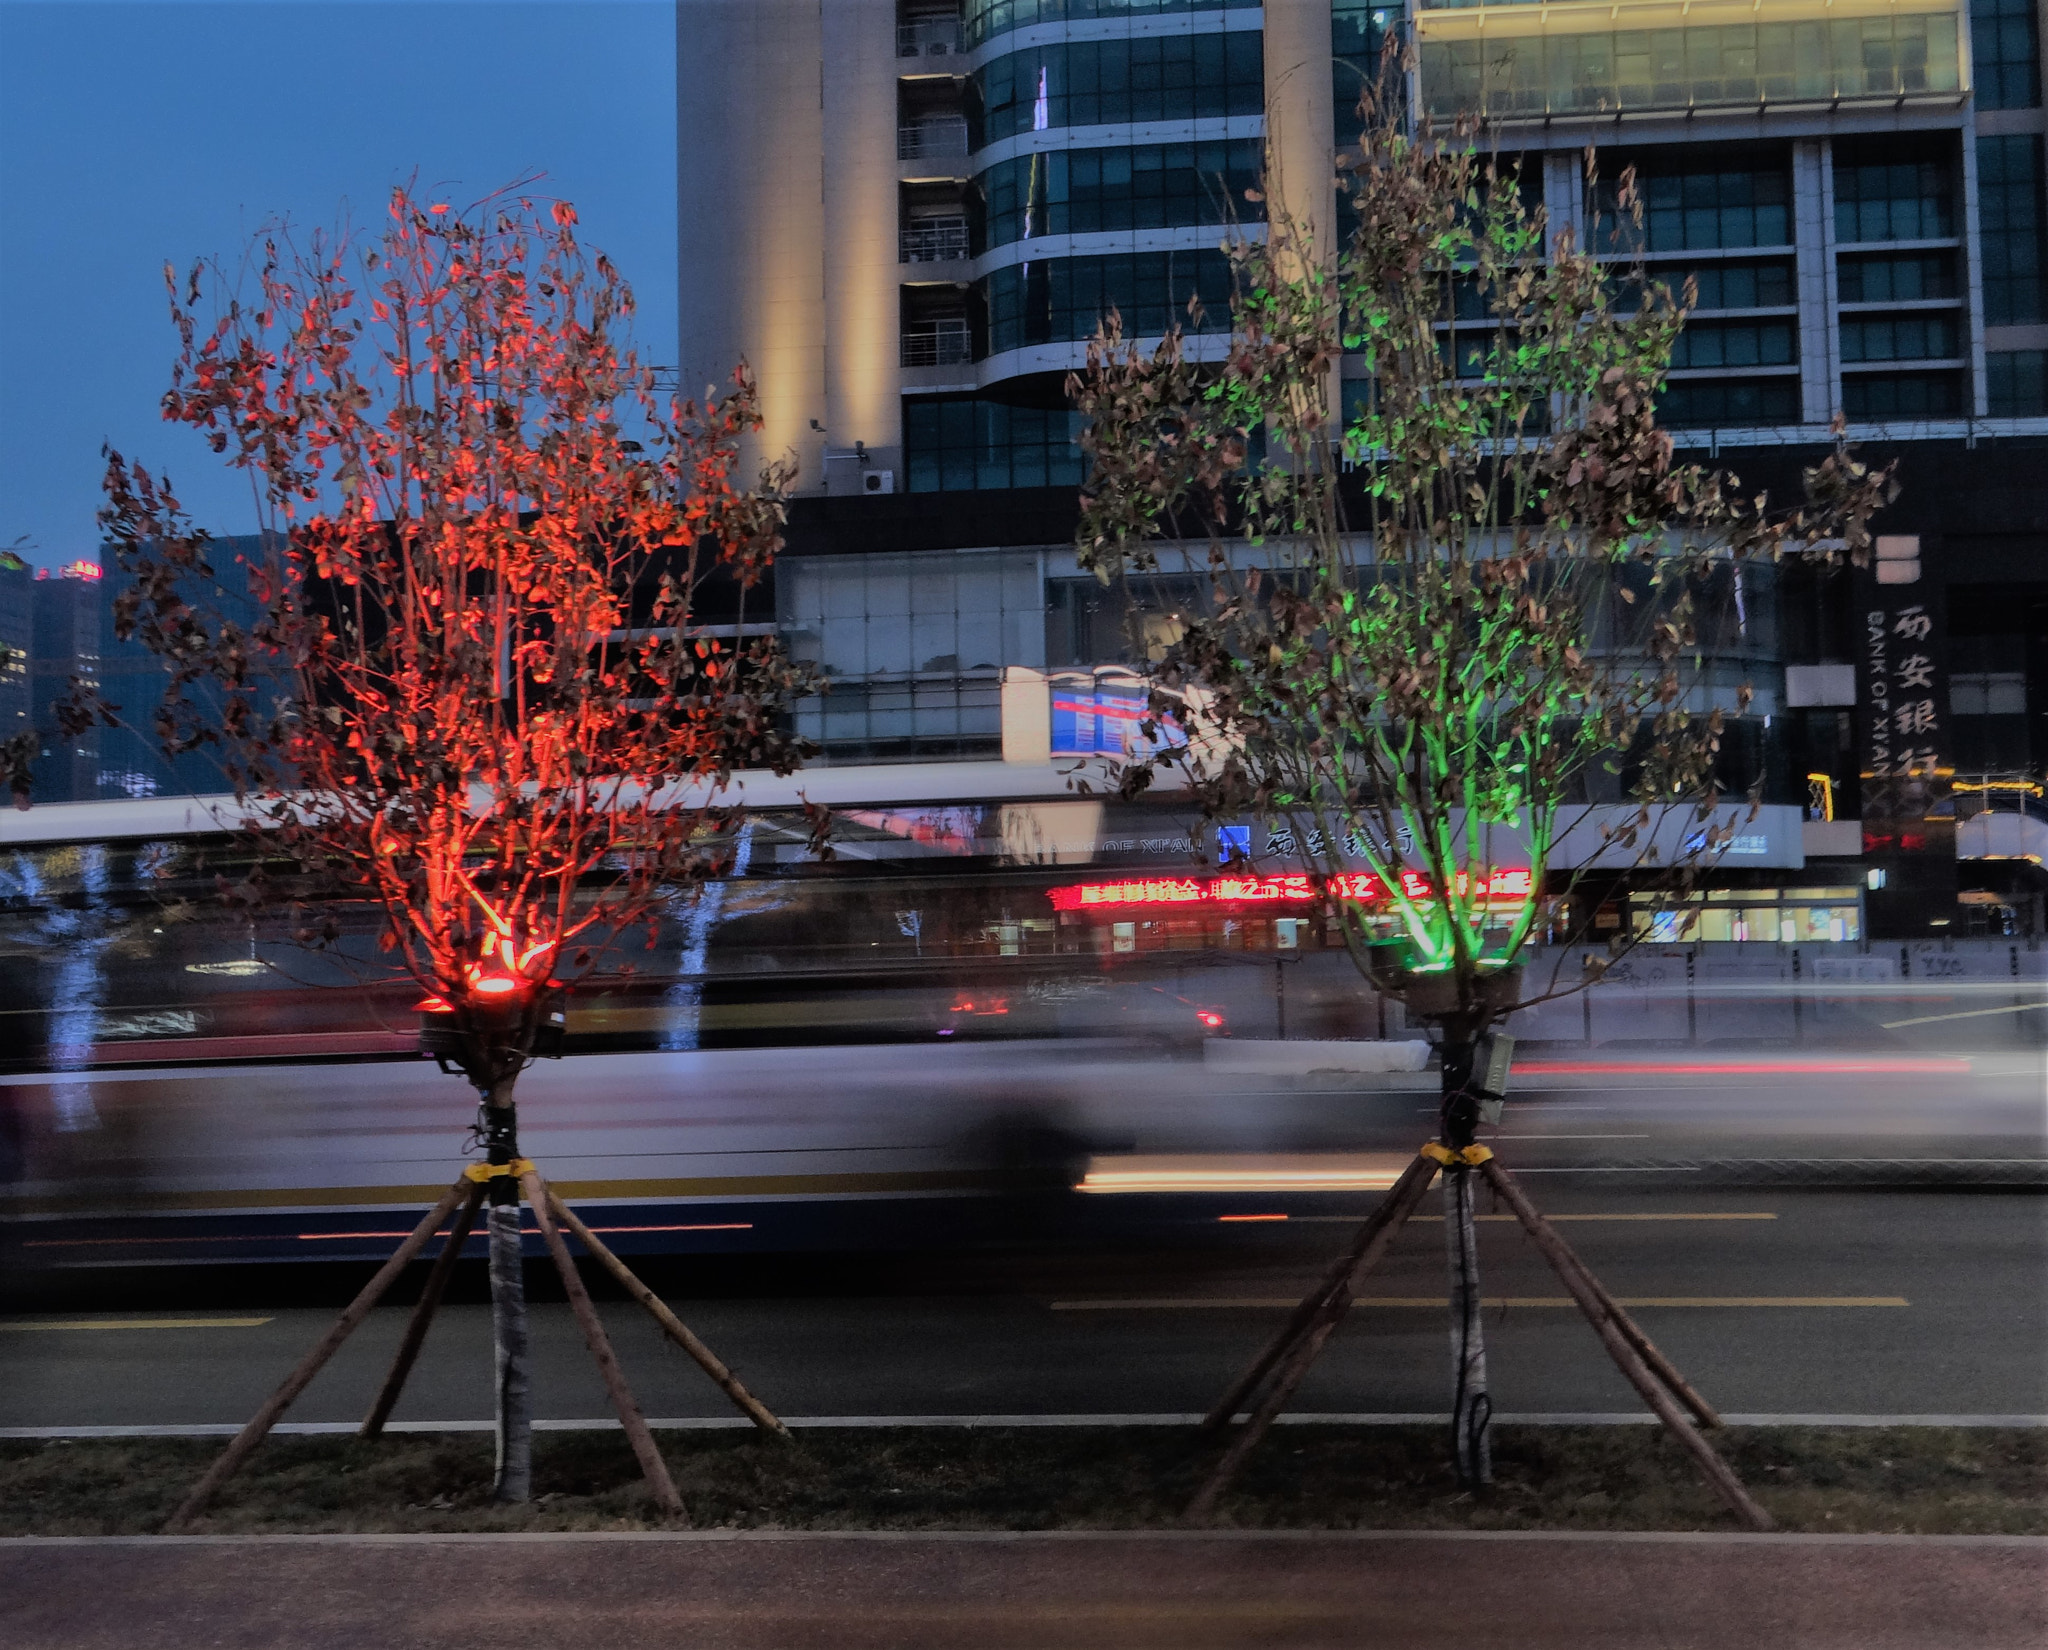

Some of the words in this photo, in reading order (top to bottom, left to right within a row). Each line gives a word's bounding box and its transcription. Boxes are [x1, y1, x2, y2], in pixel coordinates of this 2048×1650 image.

[1867, 610, 1887, 674] BANK
[1871, 681, 1888, 711] OF
[1893, 605, 1938, 780] 西安银行
[1102, 839, 1135, 854] OF
